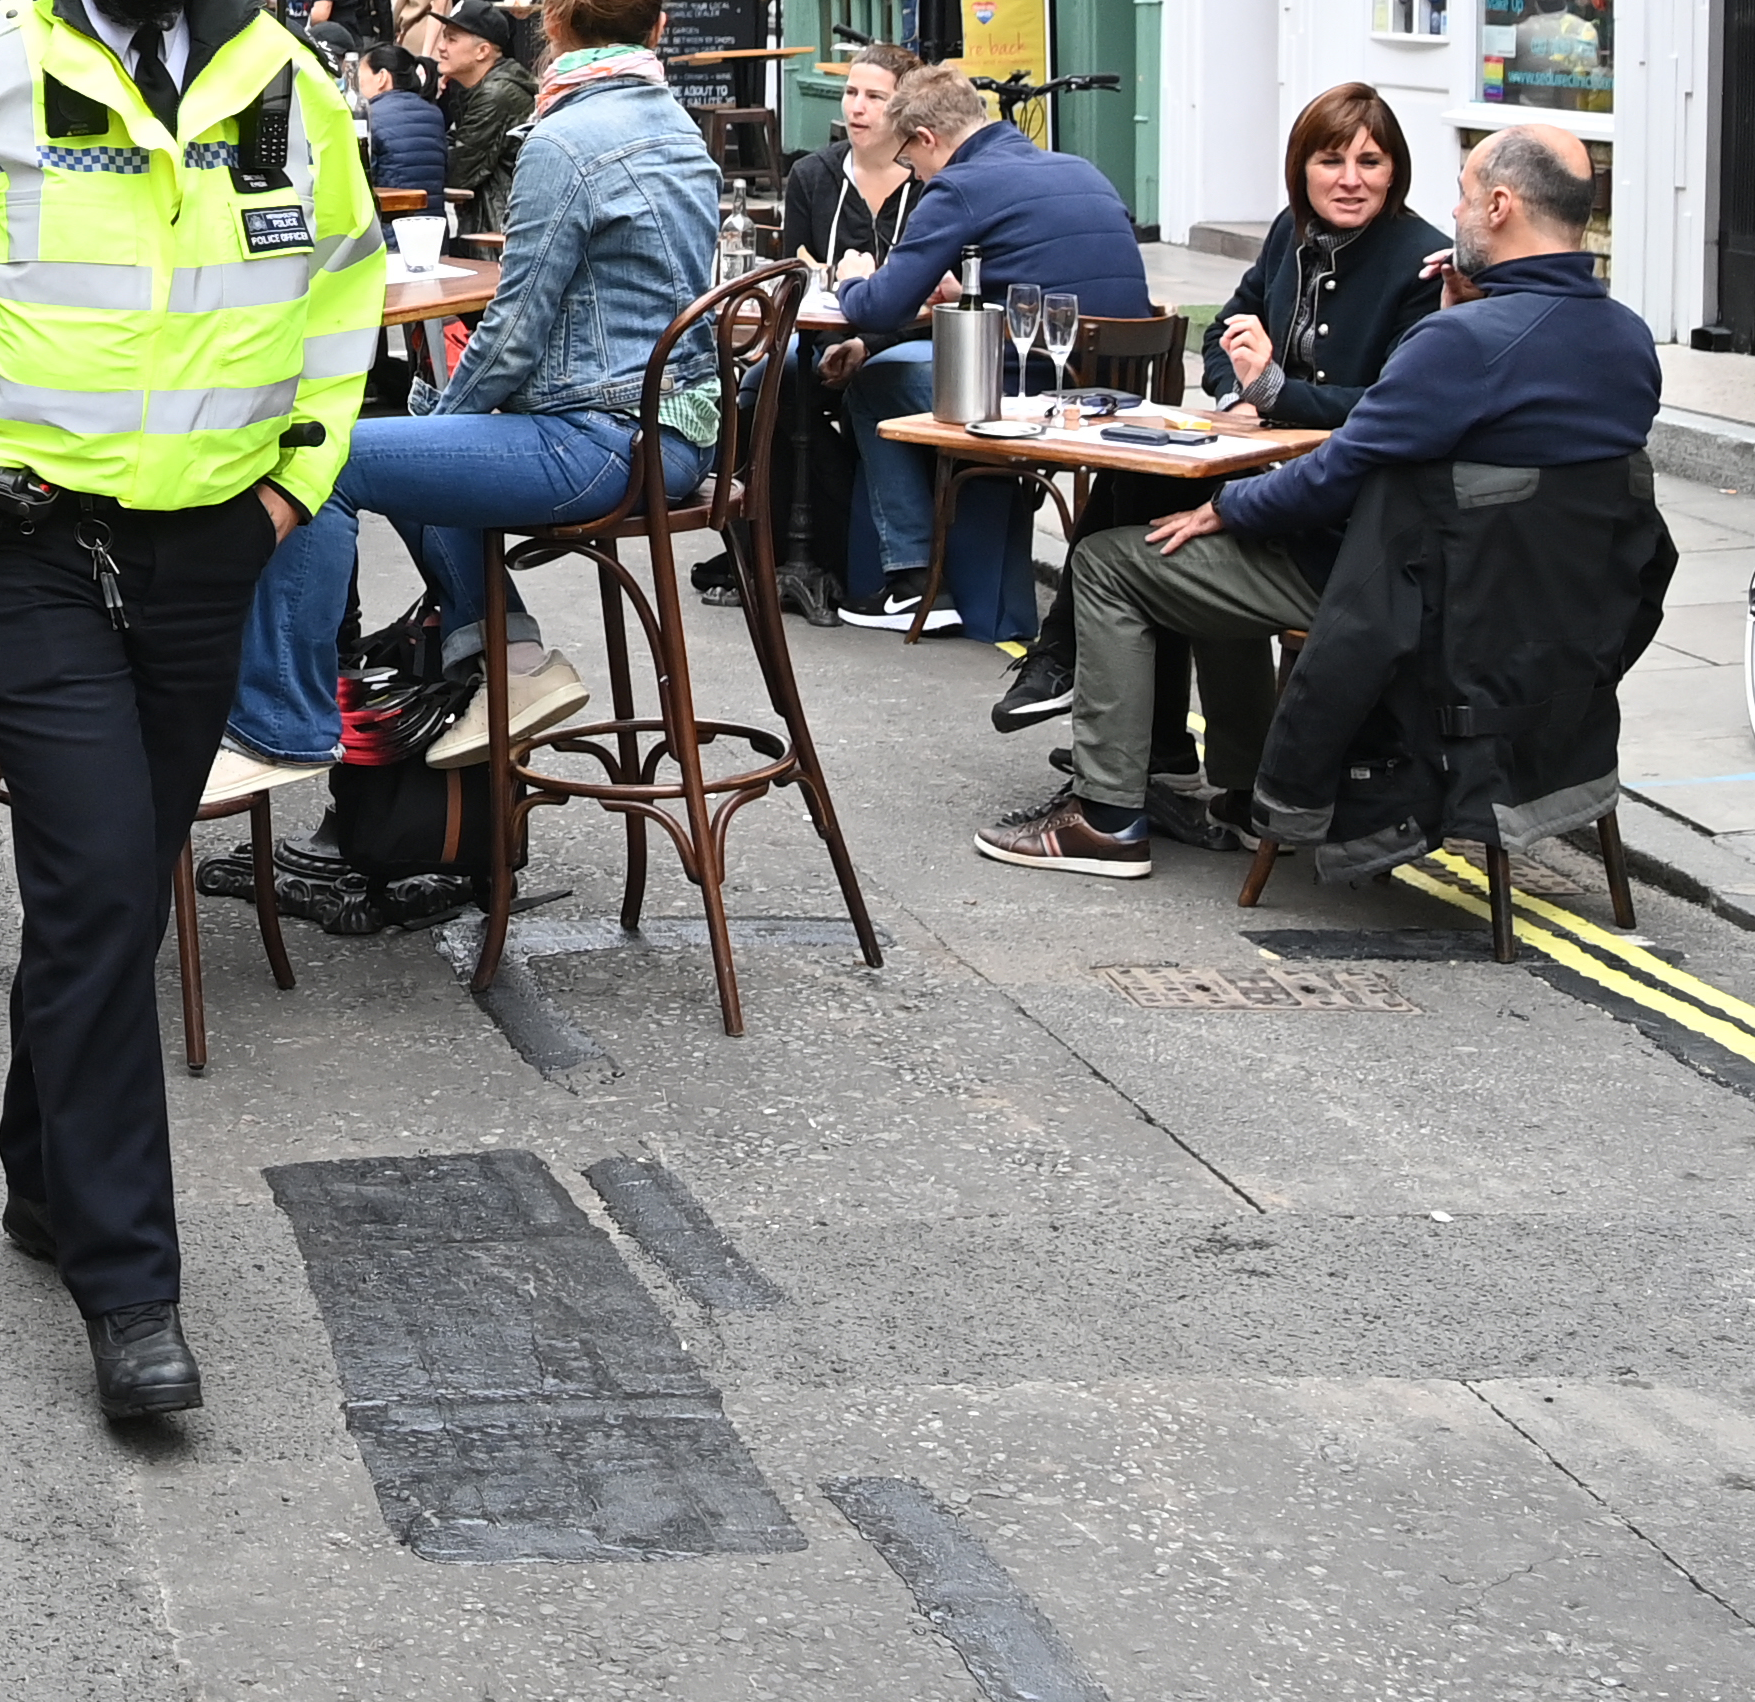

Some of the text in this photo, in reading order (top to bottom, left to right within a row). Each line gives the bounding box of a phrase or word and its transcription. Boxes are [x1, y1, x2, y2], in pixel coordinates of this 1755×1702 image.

[989, 32, 1027, 57] back
[271, 217, 299, 228] POLICE
[250, 233, 281, 247] POLICE
